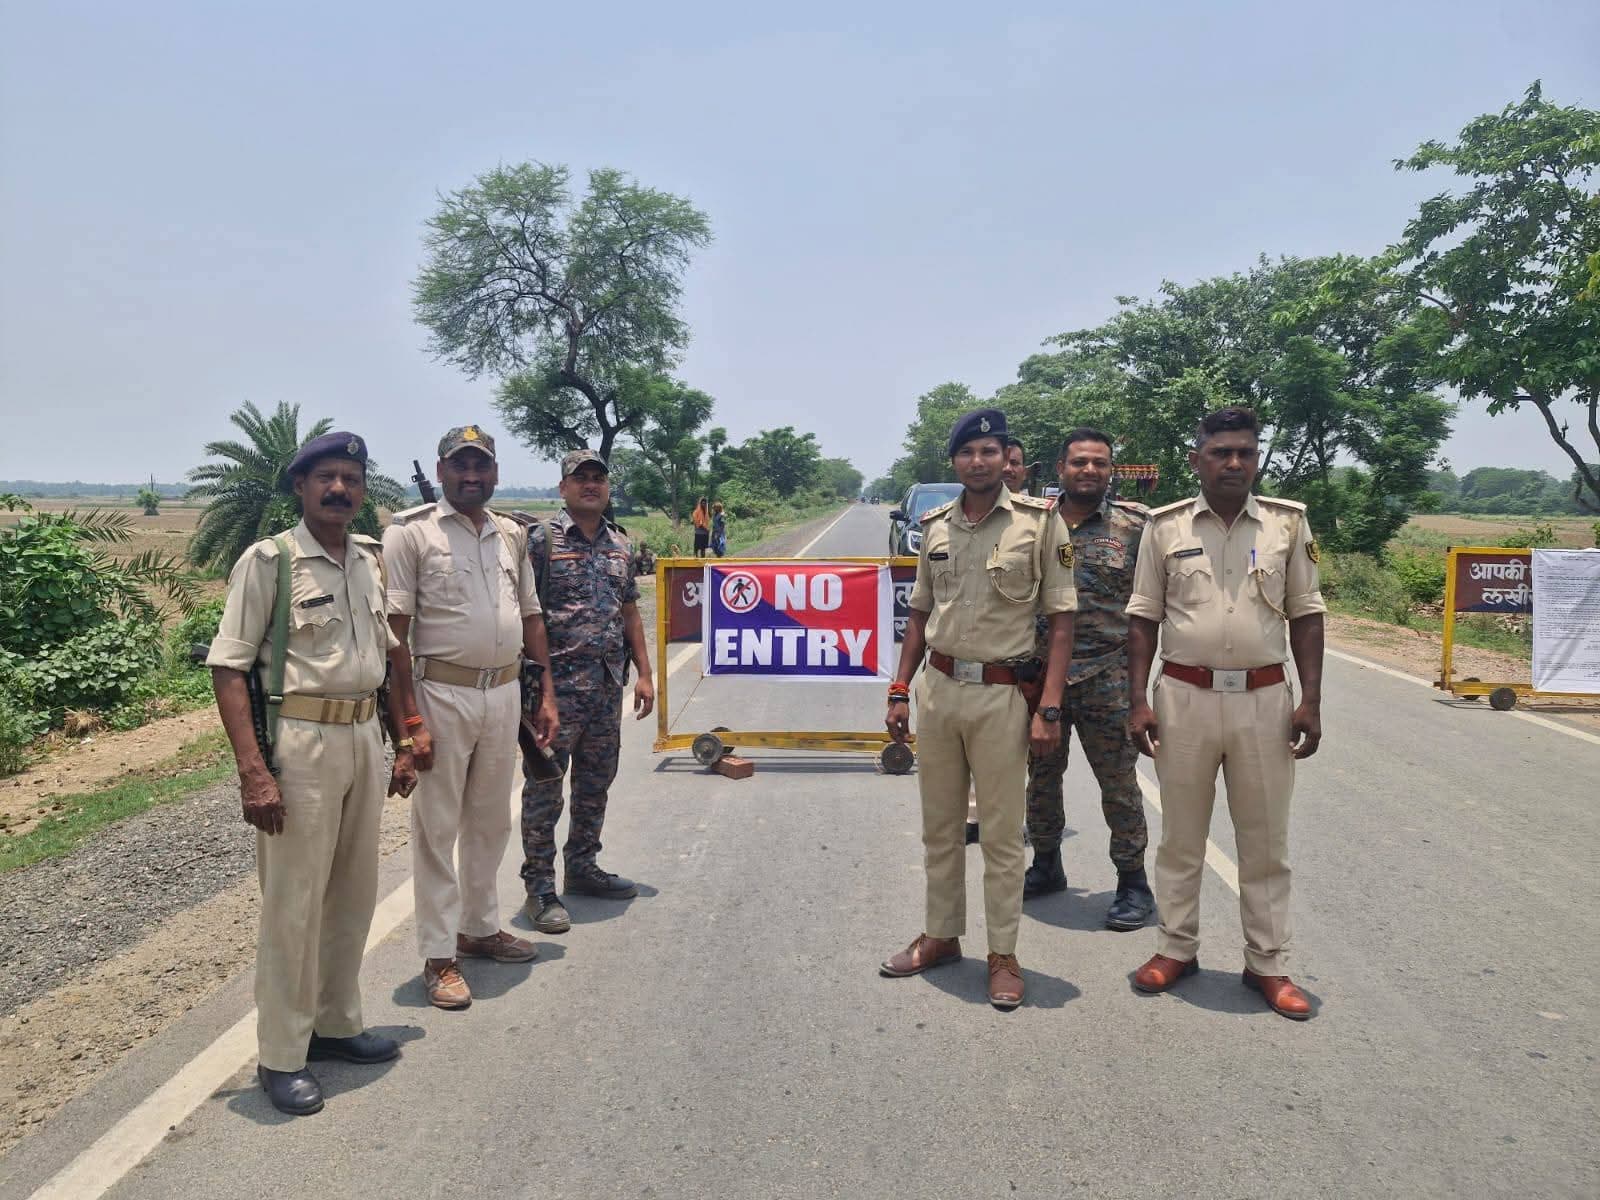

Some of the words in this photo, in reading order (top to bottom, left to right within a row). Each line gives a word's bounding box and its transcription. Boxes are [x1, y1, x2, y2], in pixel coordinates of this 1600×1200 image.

[1470, 559, 1528, 580] आपकी
[774, 573, 843, 611] NO
[1482, 583, 1532, 606] लखी
[714, 628, 873, 667] ENTRY
